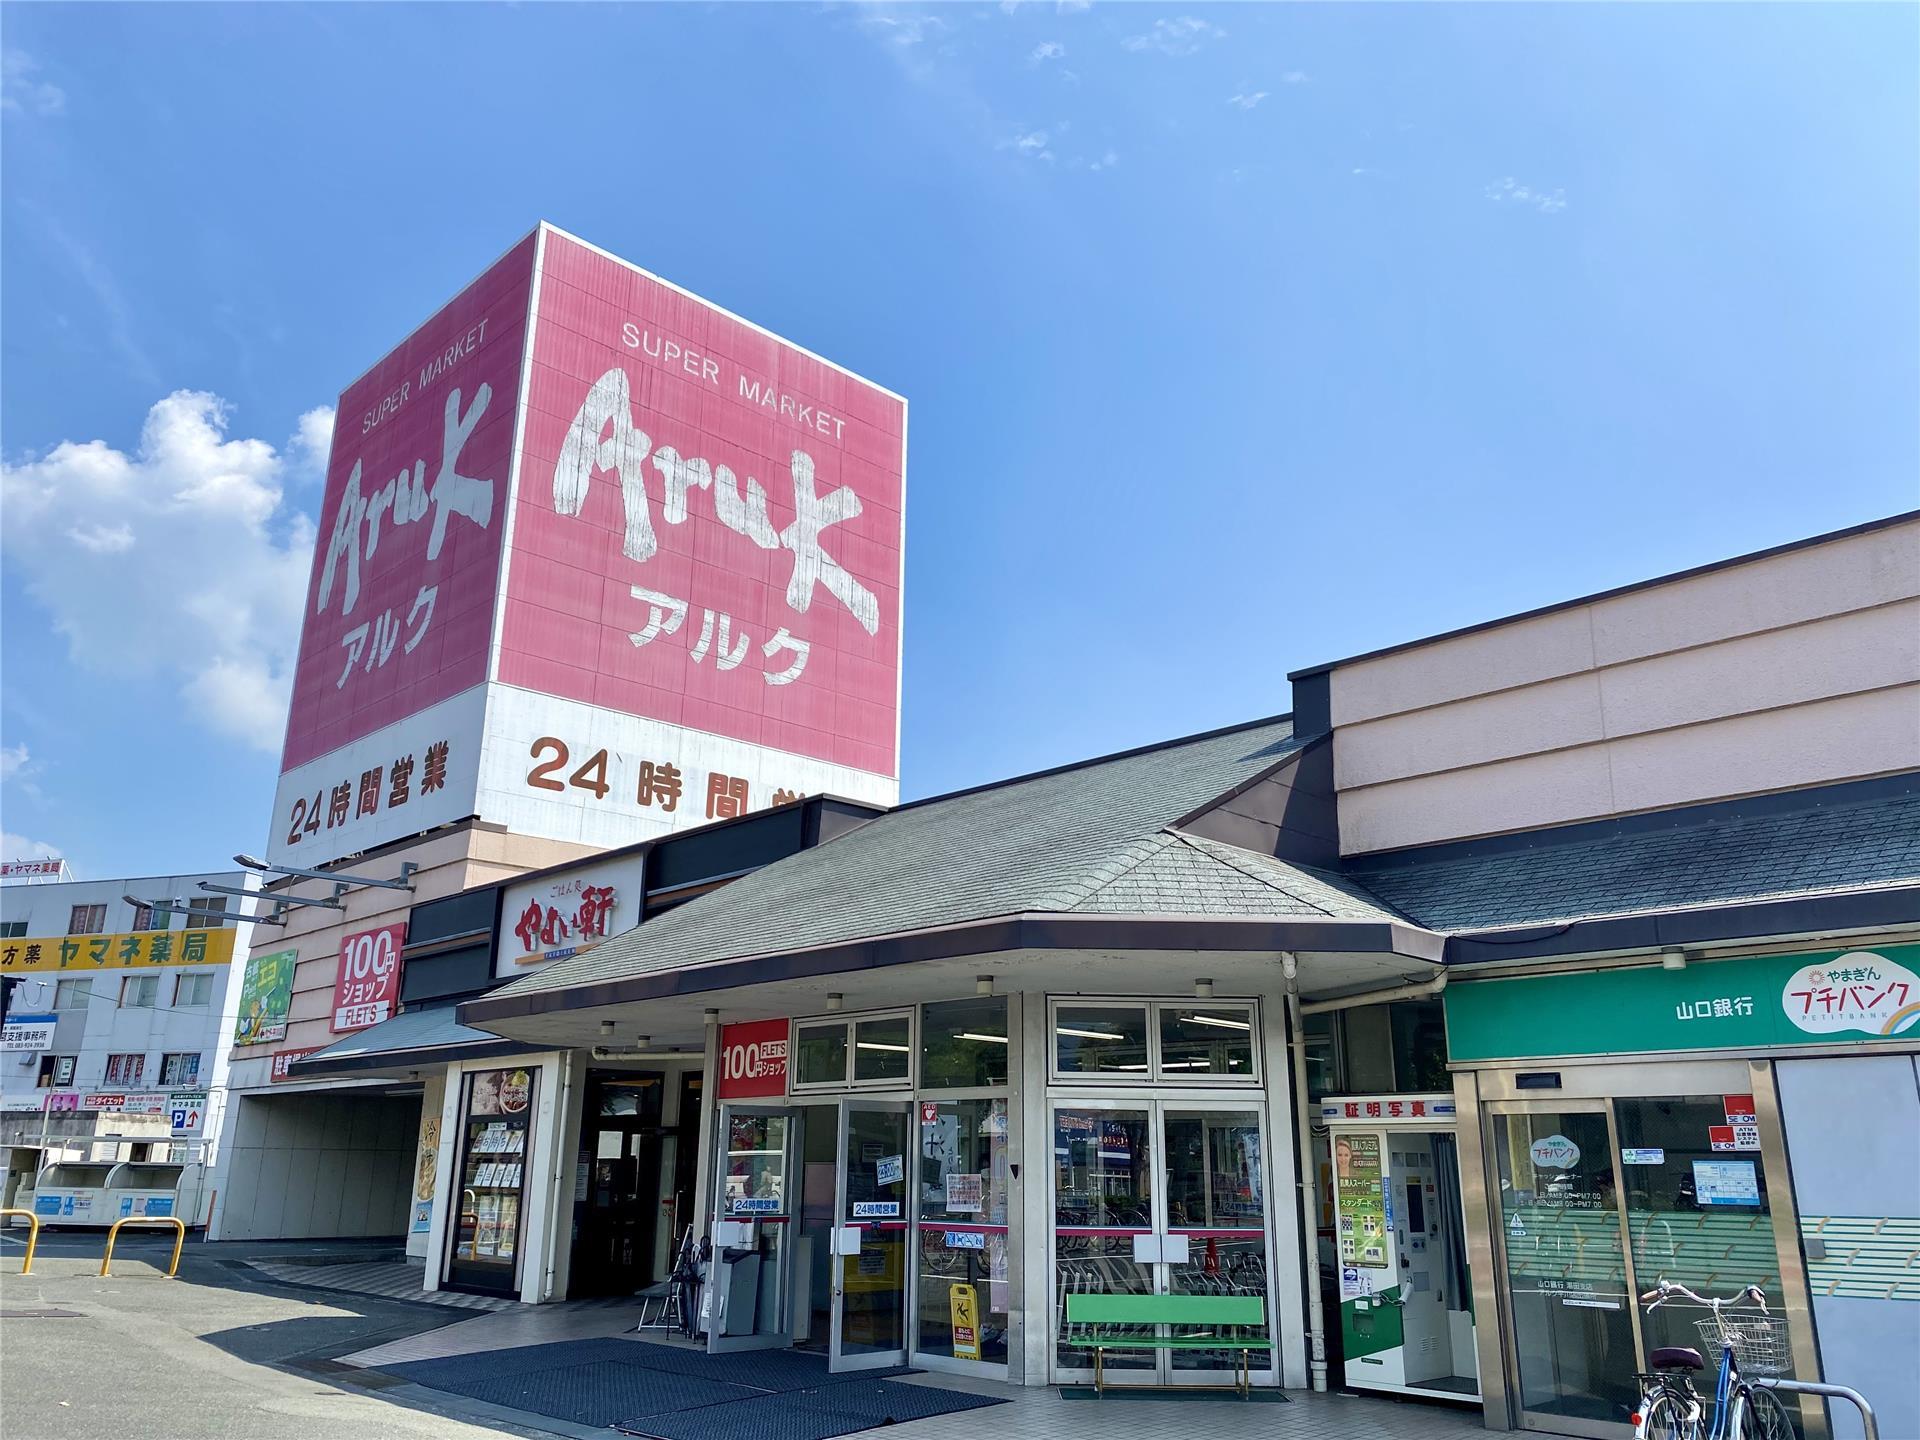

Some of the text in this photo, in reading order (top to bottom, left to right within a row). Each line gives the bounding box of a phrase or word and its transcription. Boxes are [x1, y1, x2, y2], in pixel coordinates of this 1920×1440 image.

[363, 318, 488, 434] SUPER MARKET
[621, 321, 846, 440] SUPER MARKET
[317, 381, 494, 615] Aruk
[552, 366, 880, 637] Aruk
[336, 585, 439, 690] アルク
[627, 585, 811, 686] アルク
[287, 740, 449, 846] 24時間営業
[58, 932, 208, 967] ヤマネ薬局
[344, 930, 396, 981] 100円
[1826, 966, 1881, 984] やまぎん
[342, 972, 390, 1006] ショップ
[1790, 981, 1910, 1015] プチバンク
[344, 1004, 378, 1027] FLET'S
[1675, 996, 1754, 1020] 山口銀行
[761, 1042, 787, 1057] FLET'S
[95, 1096, 125, 1106] ダイエット
[1344, 1100, 1426, 1118] 証明写真
[173, 1111, 184, 1127] P
[1727, 1115, 1756, 1123] SEOM
[1533, 1147, 1575, 1159] プチバンク
[735, 1199, 779, 1210] 24時間営業
[855, 1203, 897, 1215] 24時間営業
[1537, 1280, 1564, 1289] 山口銀行
